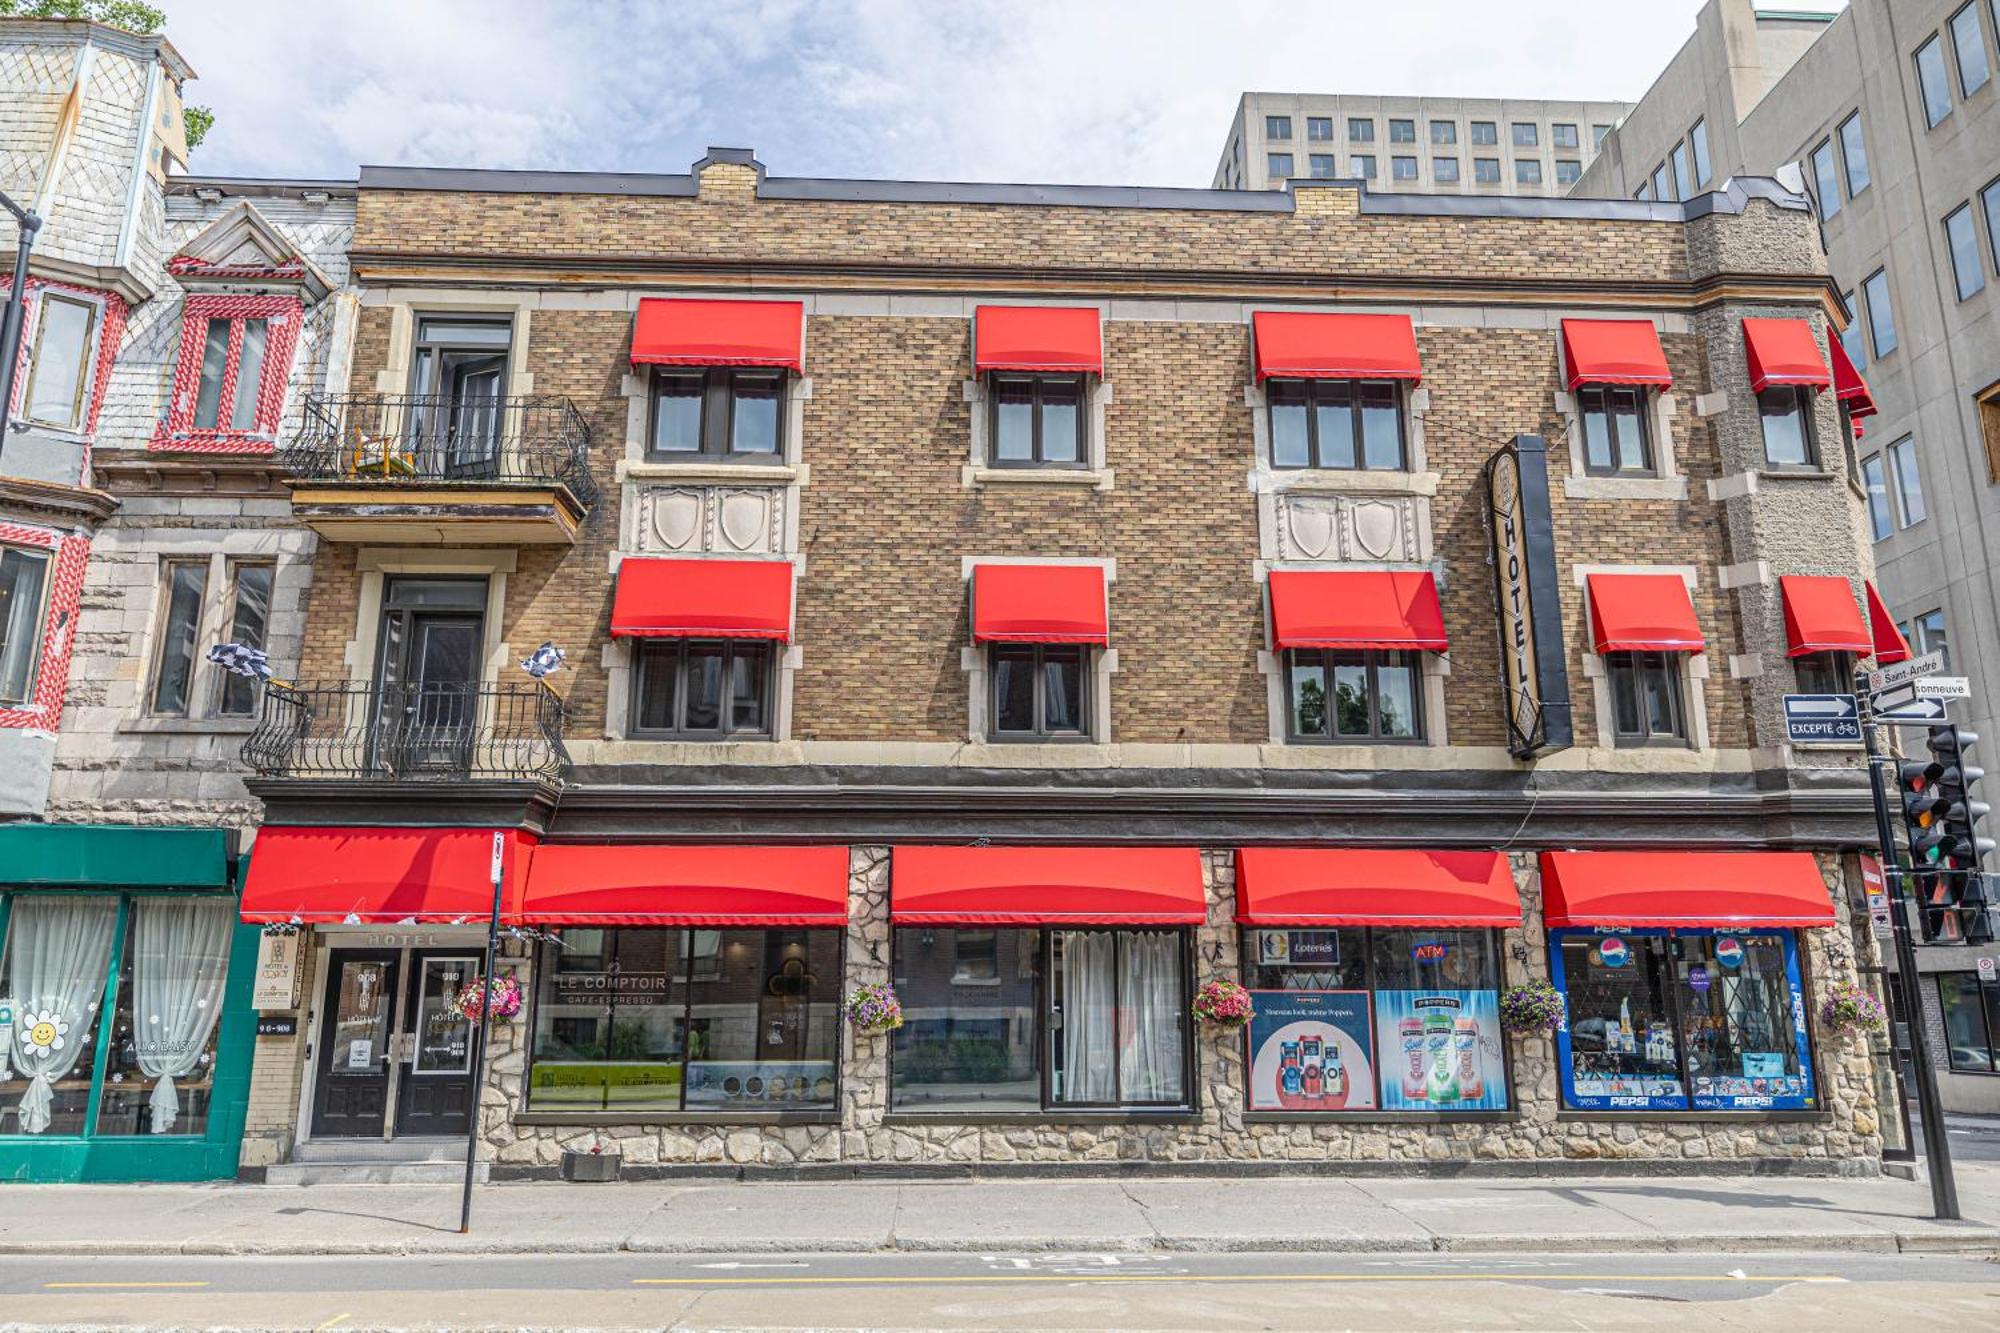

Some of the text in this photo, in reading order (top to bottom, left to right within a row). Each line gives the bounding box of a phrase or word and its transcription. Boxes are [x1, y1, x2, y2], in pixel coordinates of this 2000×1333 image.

[1505, 518, 1527, 683] HOTEL
[1885, 659, 1937, 684] Saint-André
[1791, 722, 1834, 734] EXCEPTÉ
[369, 934, 437, 945] HOTEL
[1416, 945, 1444, 958] ATM
[560, 977, 665, 989] LE COMPTOIR
[1610, 1096, 1649, 1106] PEPSI
[1734, 1096, 1774, 1106] PEPSI
